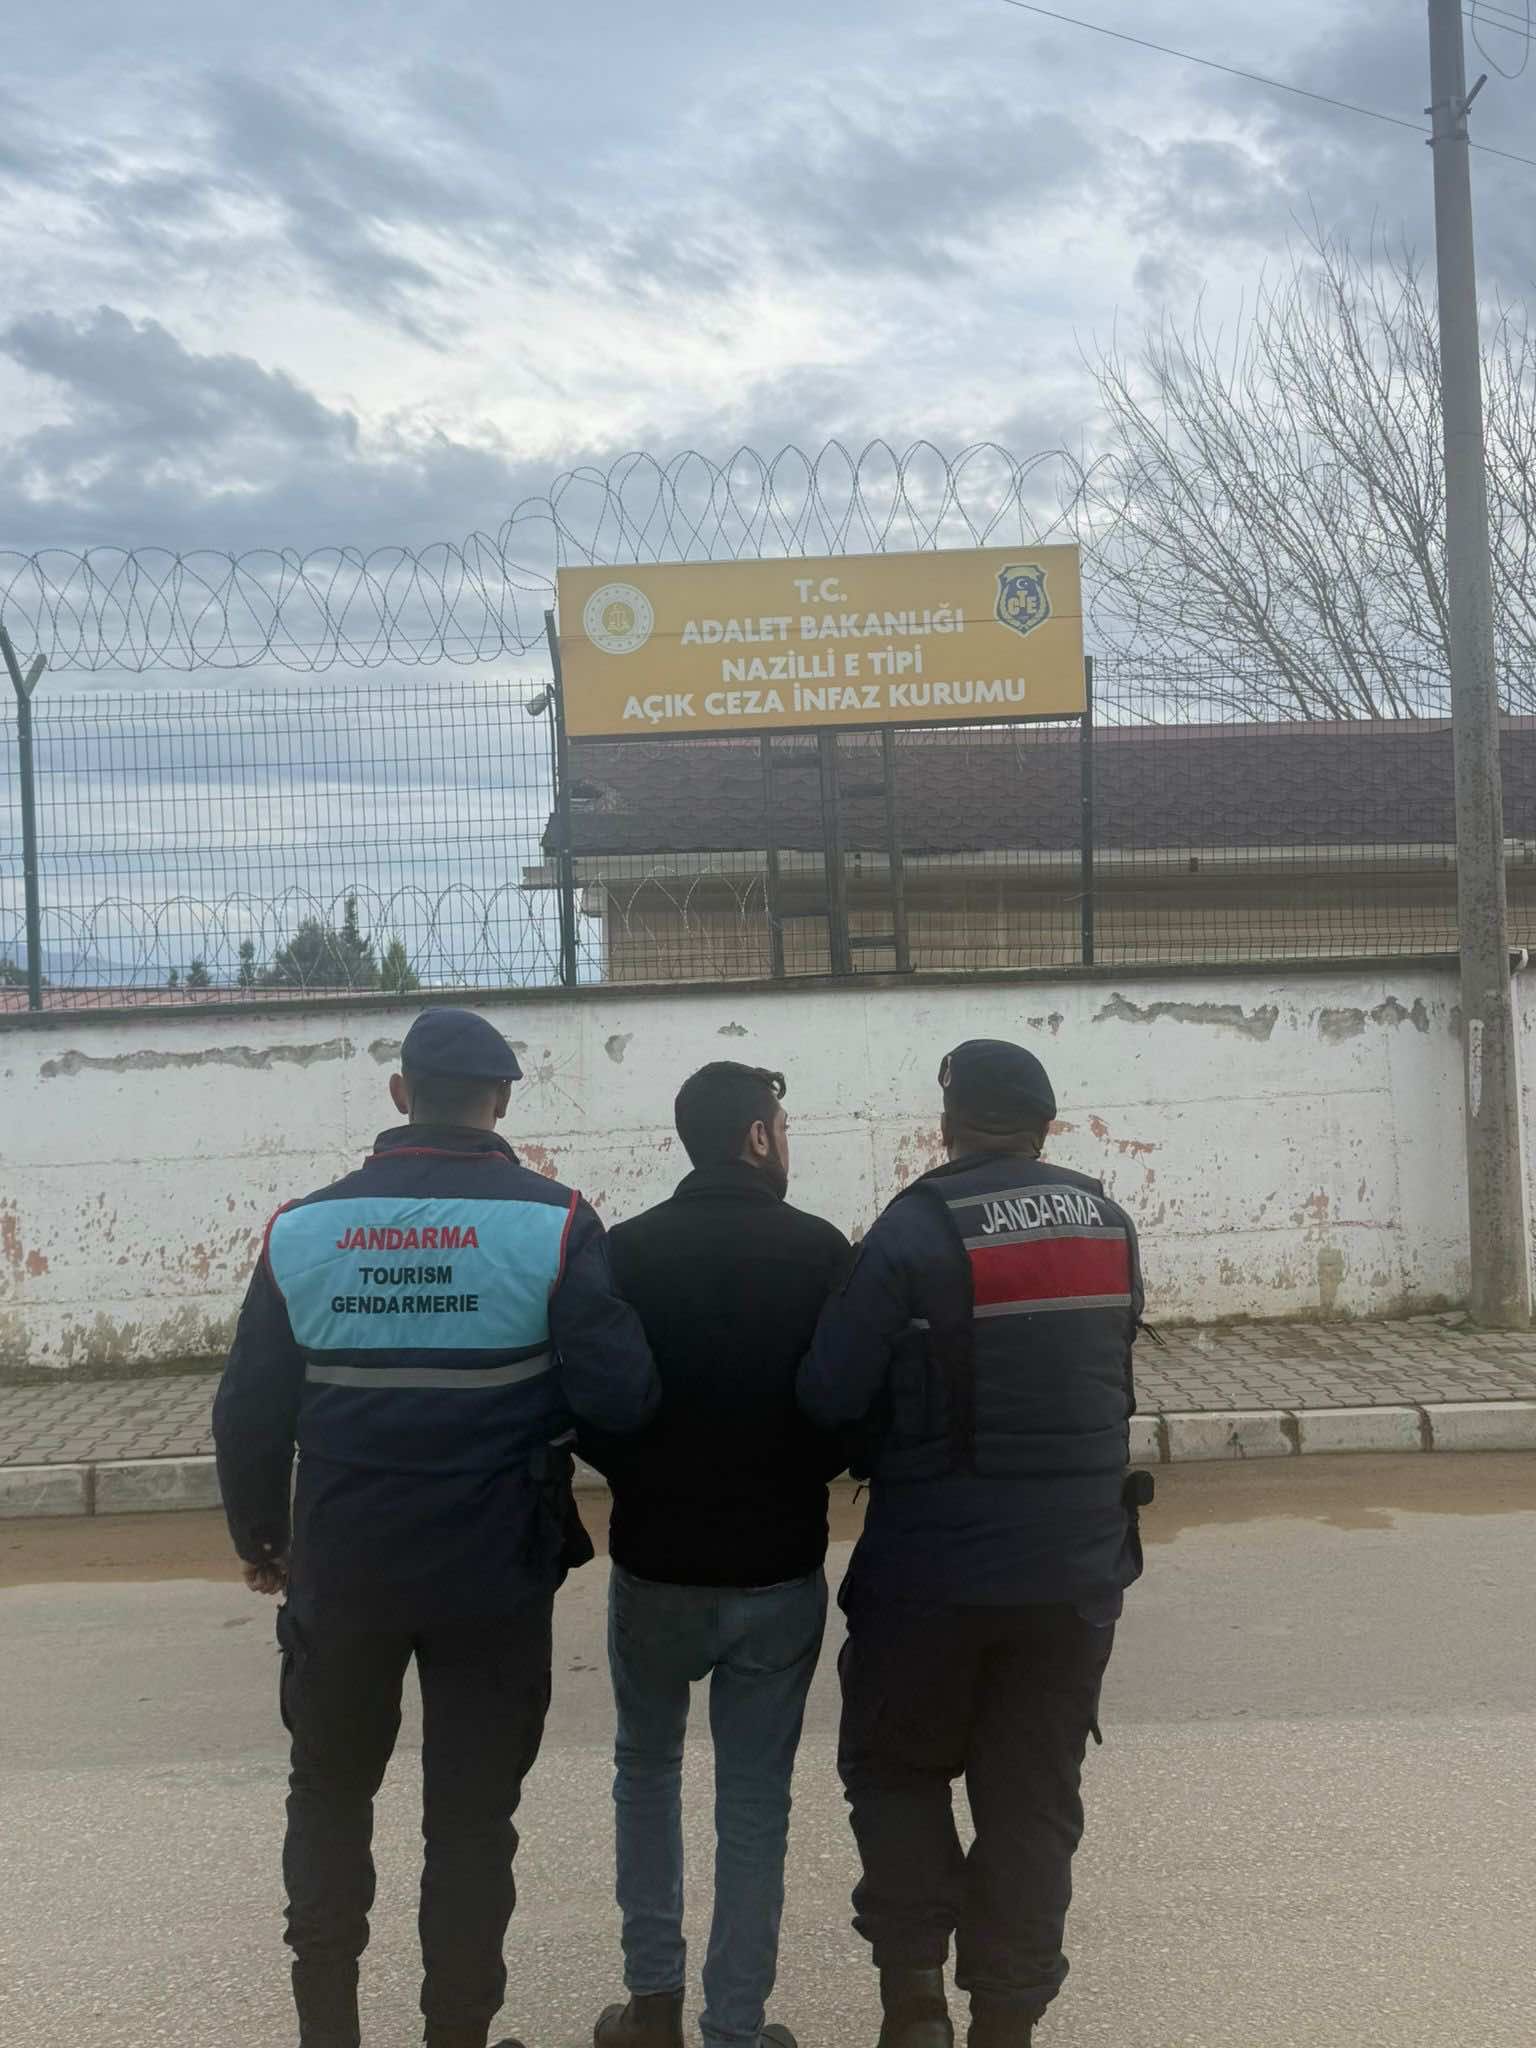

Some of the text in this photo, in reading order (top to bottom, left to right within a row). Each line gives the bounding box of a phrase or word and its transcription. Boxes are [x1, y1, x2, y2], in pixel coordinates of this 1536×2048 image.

[794, 578, 848, 603] T.C.
[681, 602, 964, 645] ADALET BAKANLIĞI
[721, 644, 923, 682] NAZİLLİ E TİPİ
[623, 678, 1025, 724] AÇIK CEZA İNFAZ KURUMU
[981, 1192, 1104, 1234] JANDARMA
[336, 1226, 479, 1250] JANDARMA
[359, 1266, 453, 1285] TOURISM
[331, 1294, 479, 1314] GENDARMERIE
